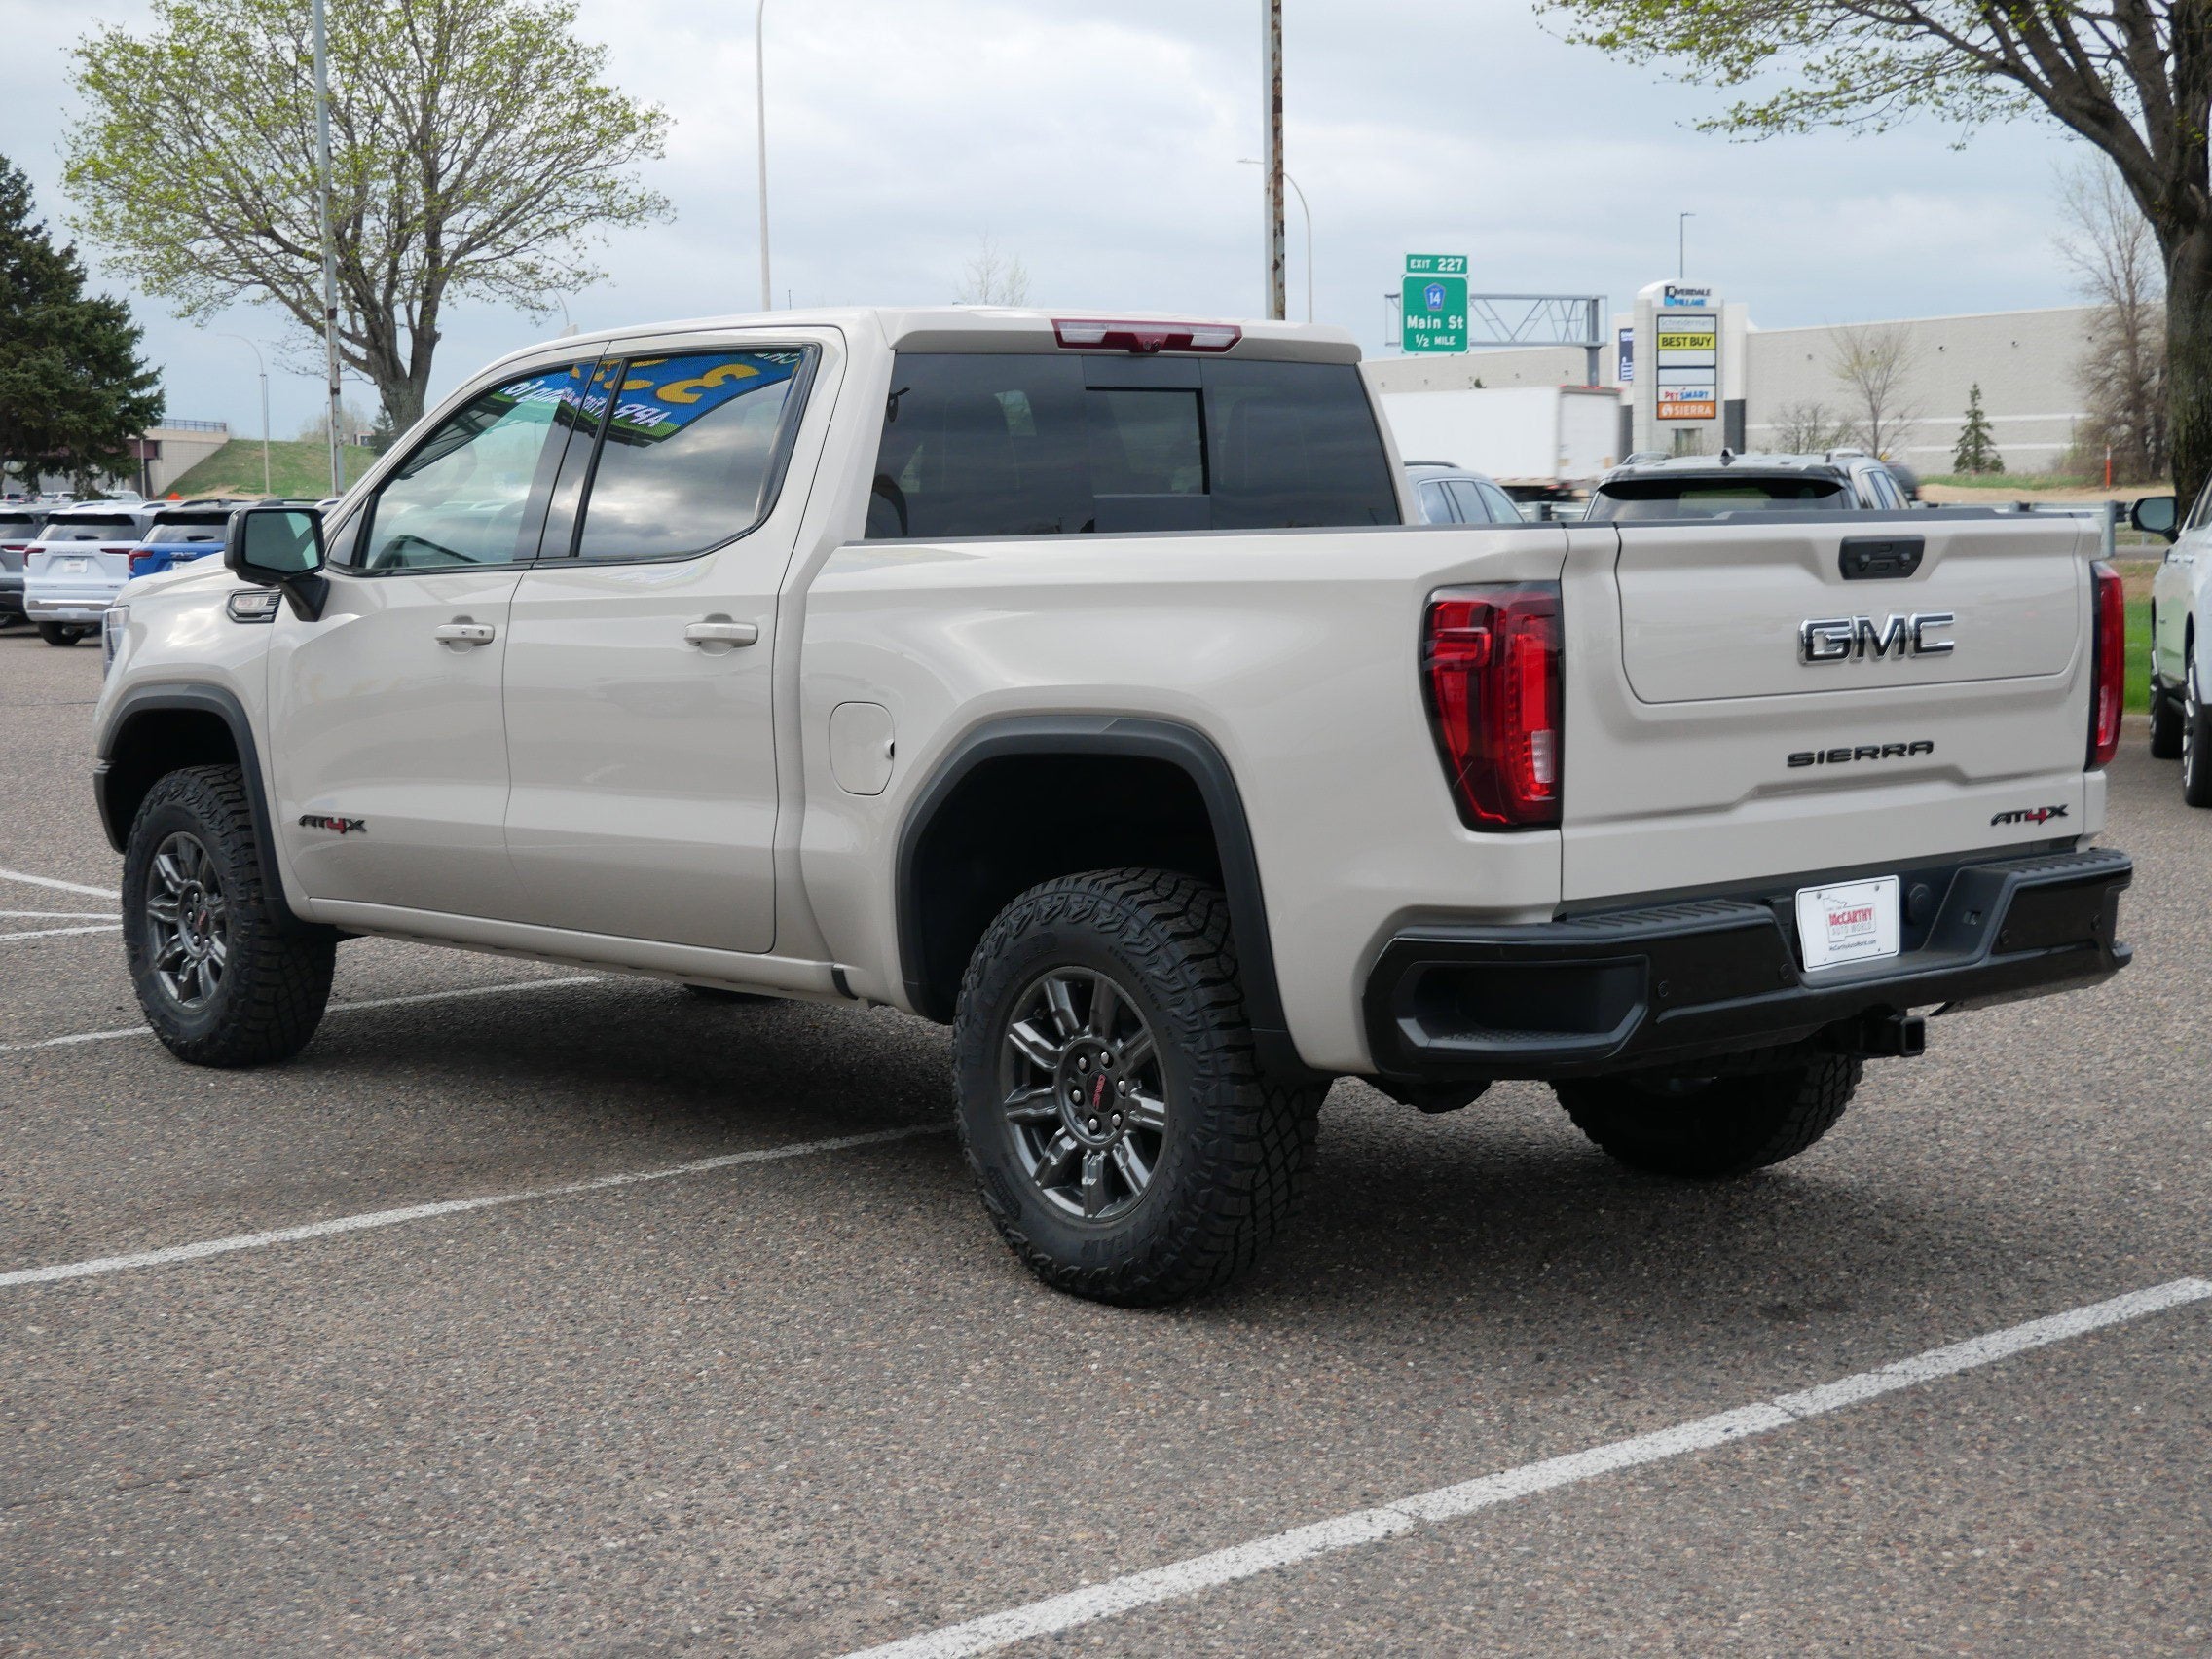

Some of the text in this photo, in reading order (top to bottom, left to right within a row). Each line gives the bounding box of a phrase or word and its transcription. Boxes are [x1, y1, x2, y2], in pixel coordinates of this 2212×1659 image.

[1410, 257, 1464, 272] EXIT 227
[1429, 291, 1441, 305] 14
[1406, 314, 1464, 330] Main St
[1434, 335, 1456, 346] MILE
[1662, 336, 1712, 347] BEST BUY
[1674, 405, 1711, 416] SIERRA
[1798, 611, 1954, 665] GMC
[1788, 740, 1935, 767] SIERRA
[1990, 804, 2069, 827] AT4X
[298, 814, 367, 834] AT4X
[1828, 907, 1873, 927] McCARTHY
